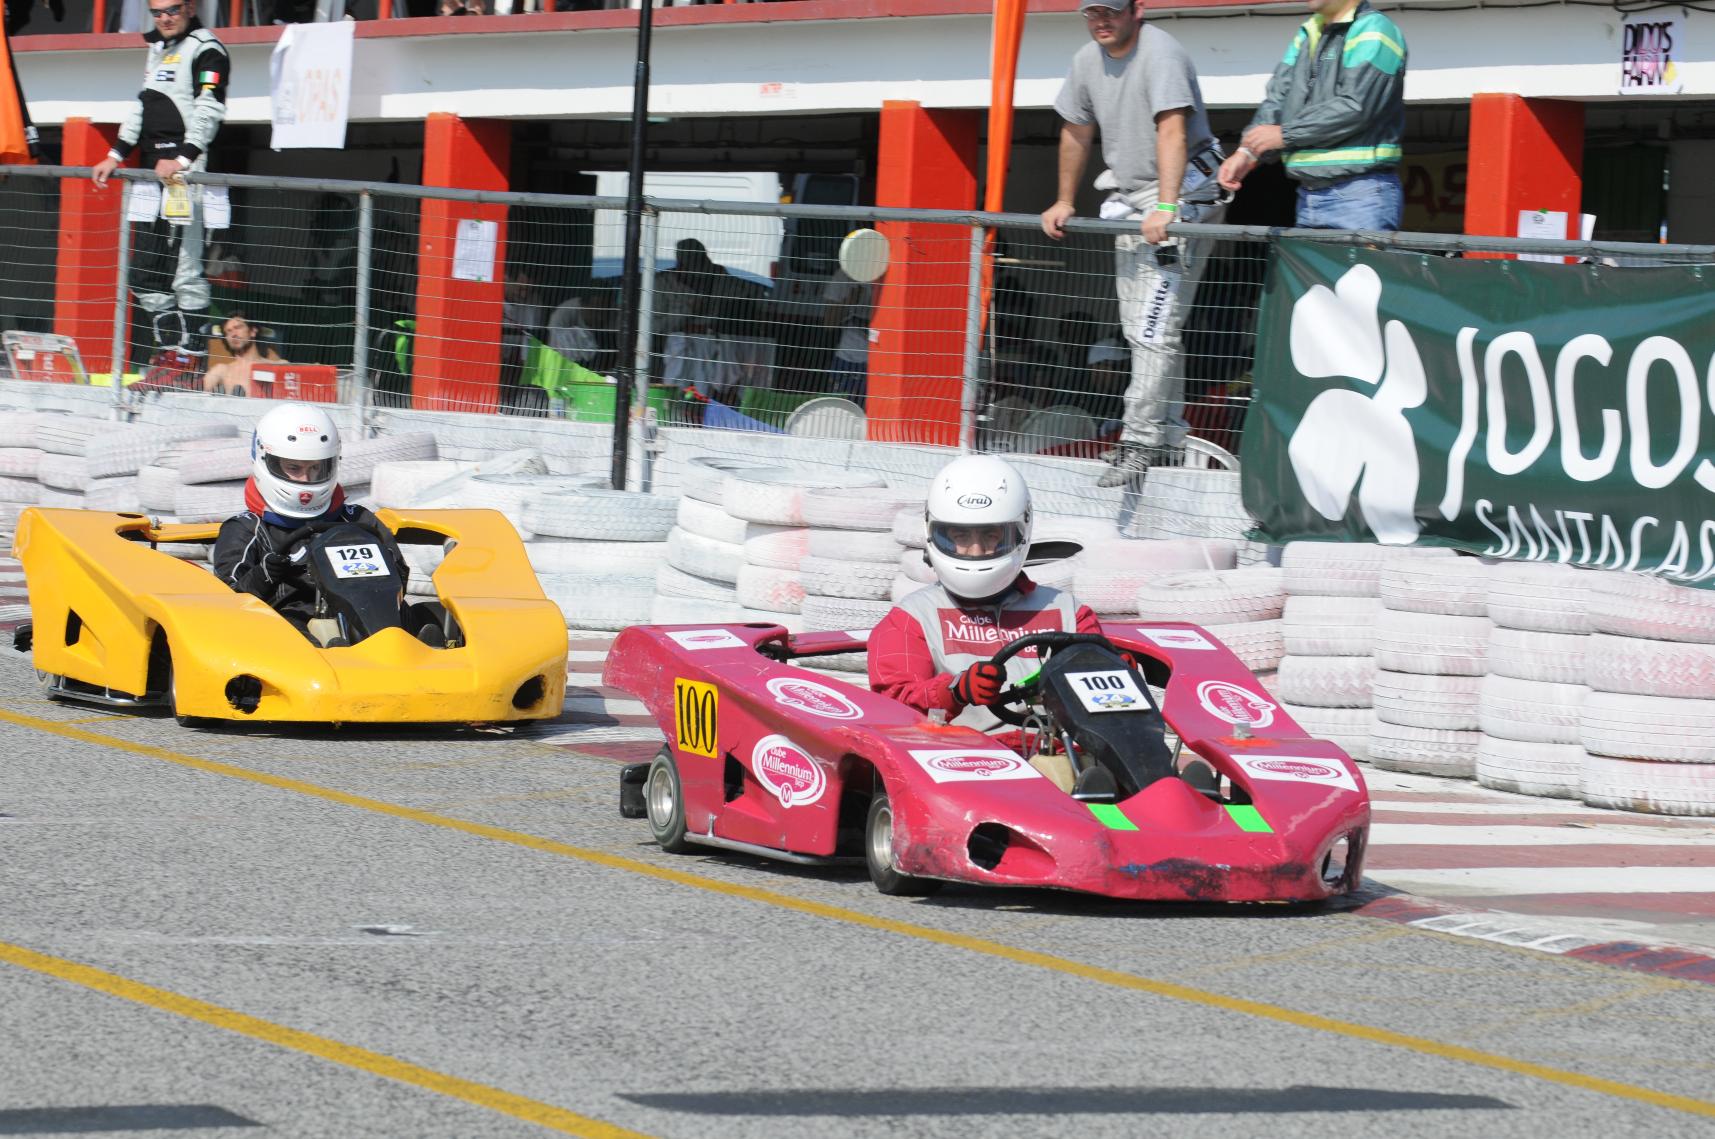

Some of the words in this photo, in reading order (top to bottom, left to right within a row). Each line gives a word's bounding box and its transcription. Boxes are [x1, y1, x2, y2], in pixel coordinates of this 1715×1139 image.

[959, 495, 989, 505] Arai
[336, 547, 374, 561] 129
[1079, 675, 1125, 691] 100
[676, 683, 717, 754] 100
[761, 751, 813, 782] Millennium
